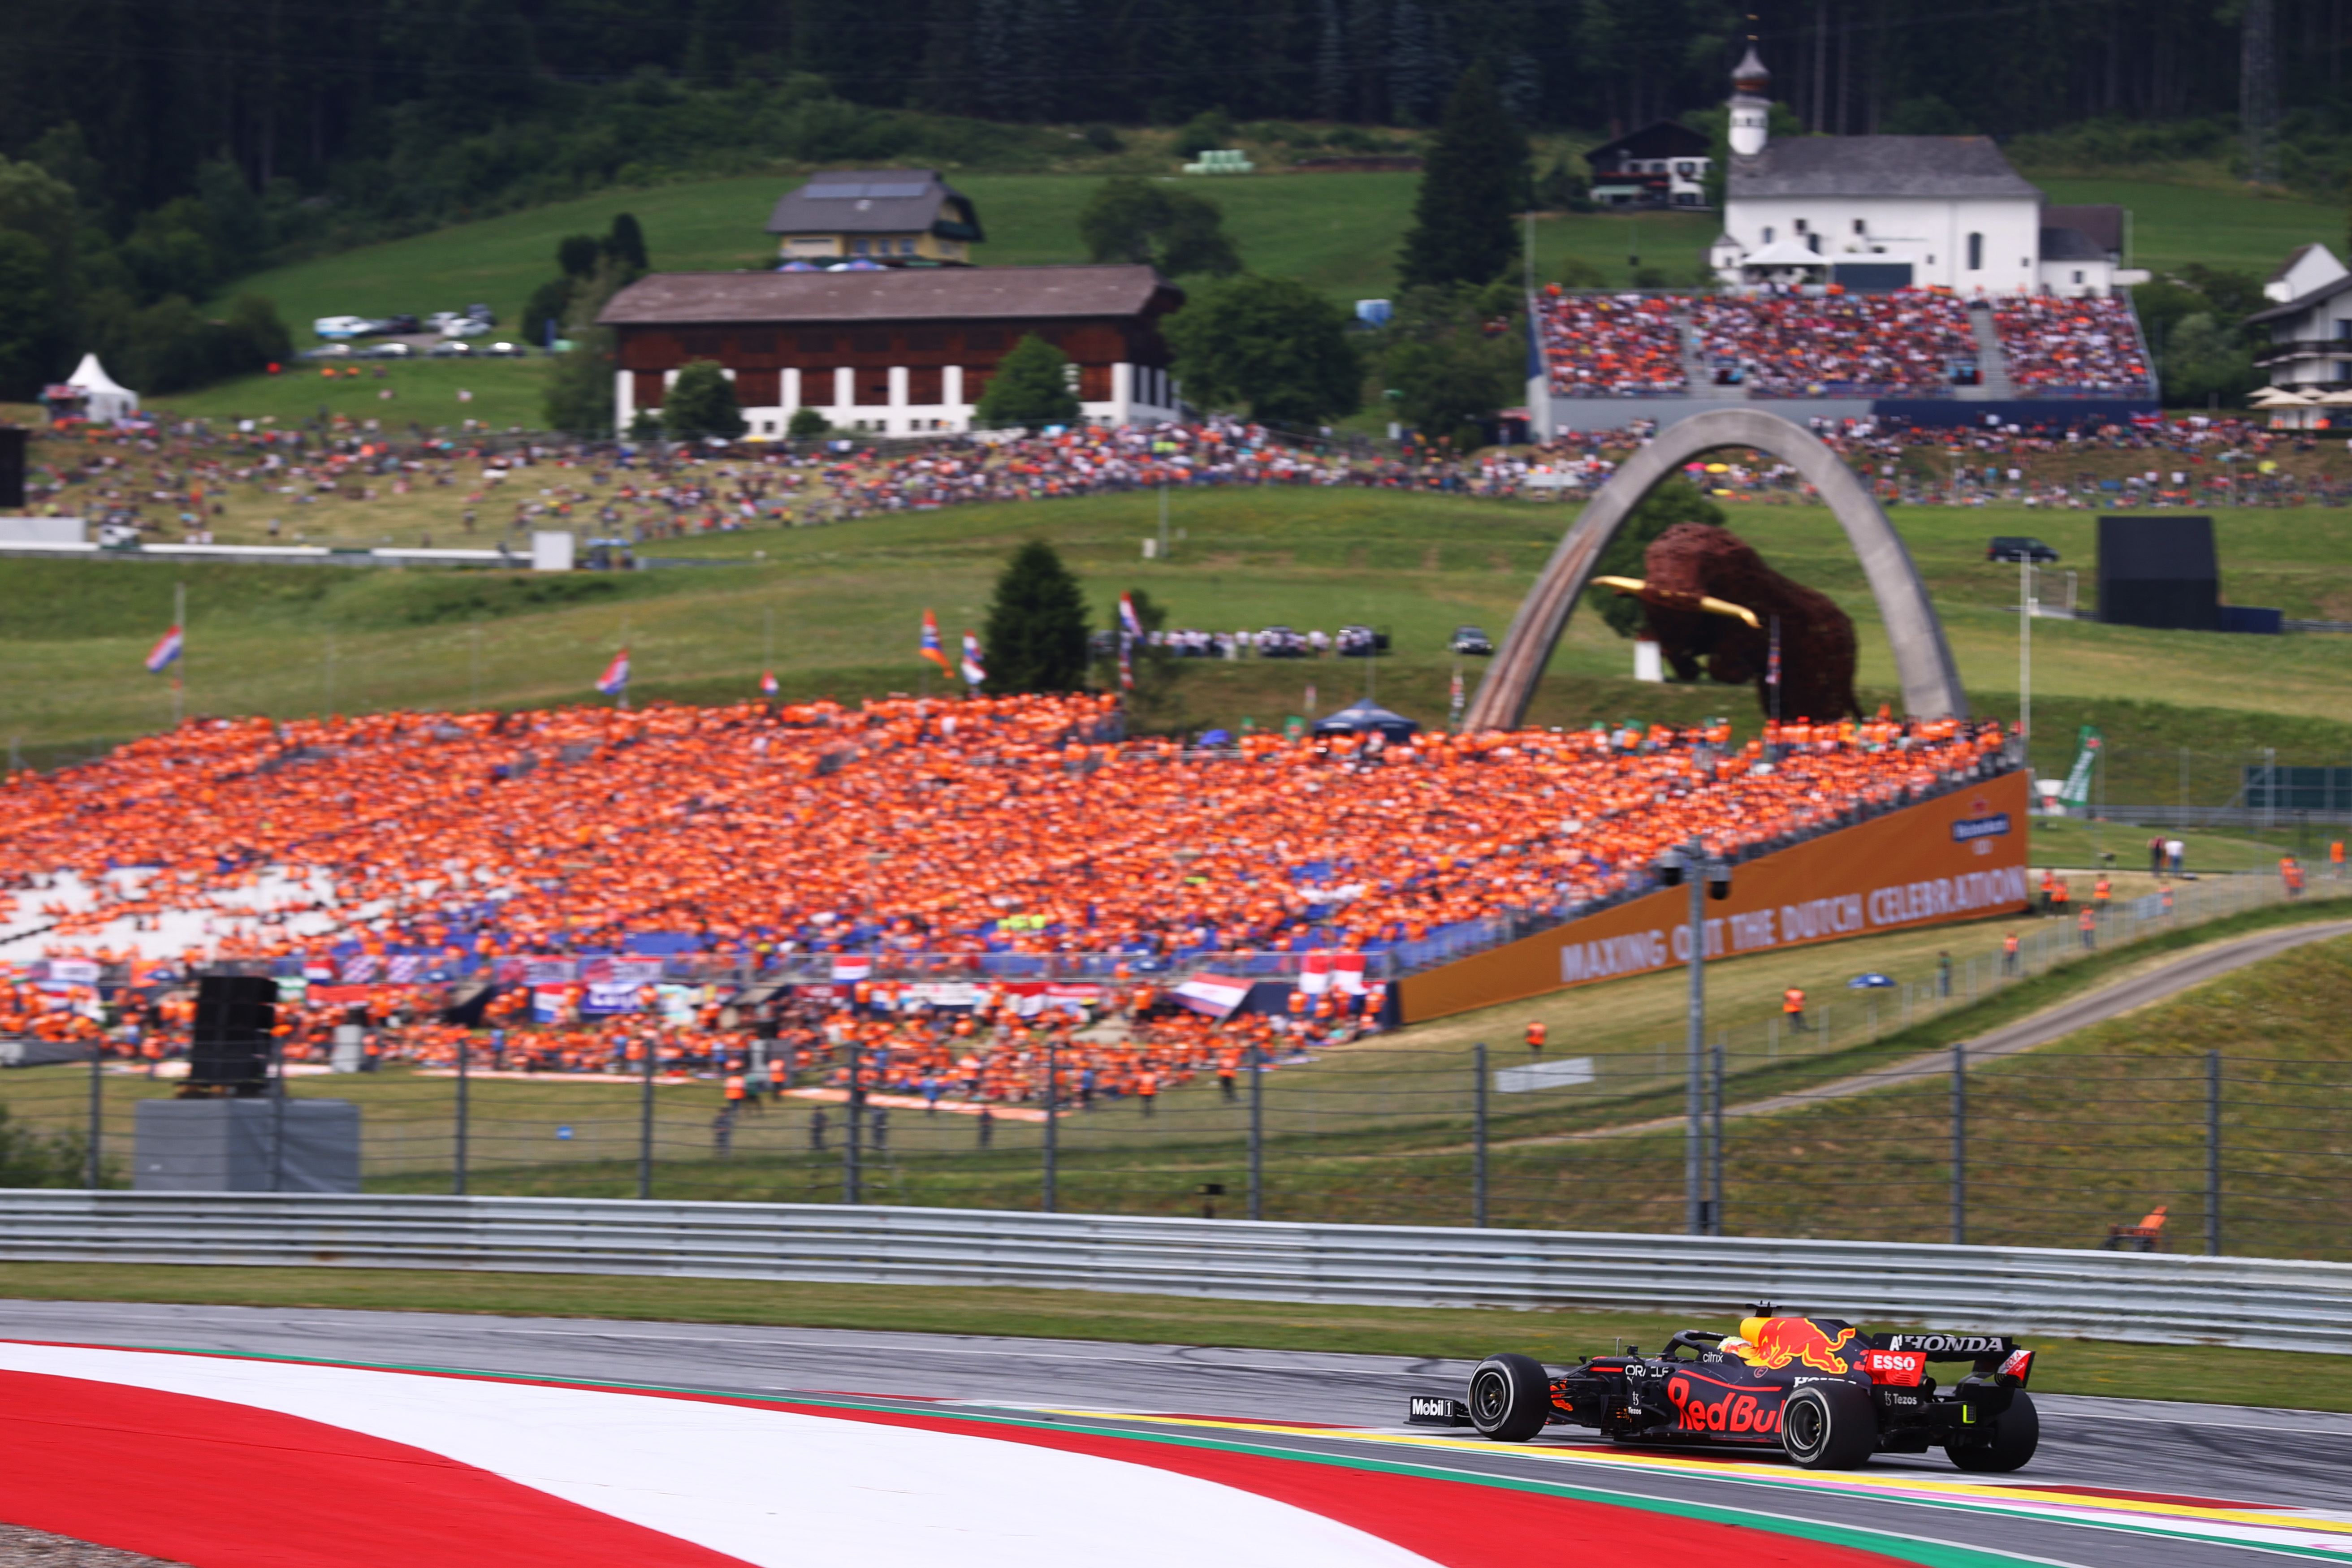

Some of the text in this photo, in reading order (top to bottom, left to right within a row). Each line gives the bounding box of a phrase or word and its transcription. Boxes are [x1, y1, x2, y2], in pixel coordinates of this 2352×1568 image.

[1561, 929, 1667, 982] MAXING
[1727, 909, 1776, 950] THE
[1781, 894, 1863, 941] DUTCH
[1867, 864, 2027, 925] CELEBRATION
[1905, 1336, 2004, 1352] HONDA
[1873, 1355, 1915, 1371] ESSO
[1893, 1393, 1917, 1405] Tezos
[1413, 1399, 1444, 1416] Mobil
[1628, 1407, 1642, 1415] Tezos
